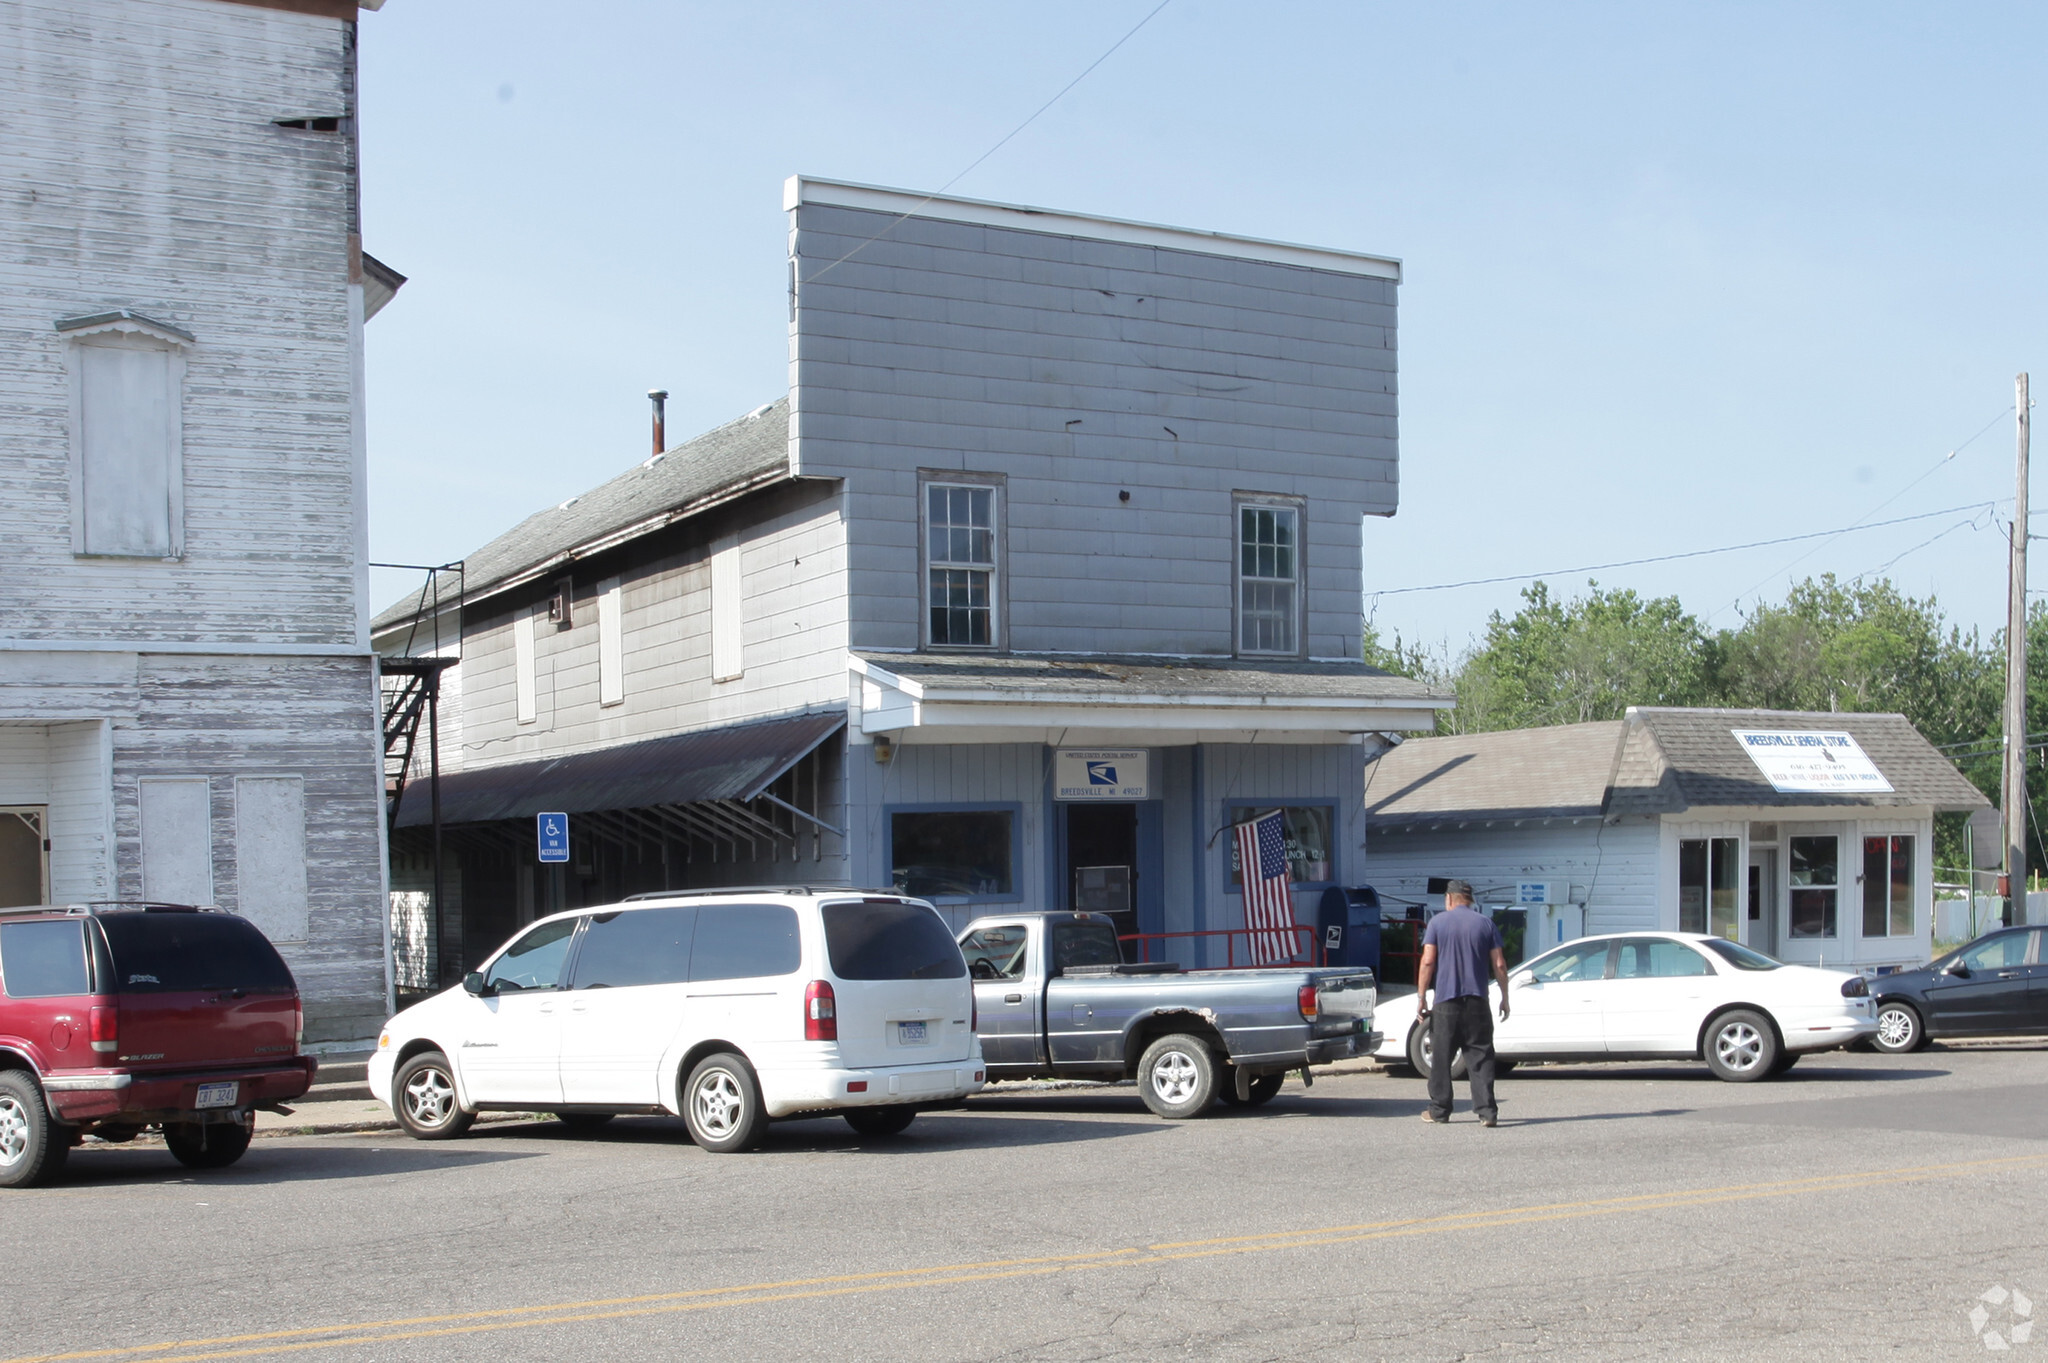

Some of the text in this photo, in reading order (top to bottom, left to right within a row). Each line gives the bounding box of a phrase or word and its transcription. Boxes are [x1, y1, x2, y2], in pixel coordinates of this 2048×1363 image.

[1744, 735, 1851, 747] BREEDSVILLE GENERAL STORE
[1061, 787, 1102, 796] BREEDSVILLE
[1123, 787, 1143, 796] 49027
[129, 1053, 165, 1061] BLAZER
